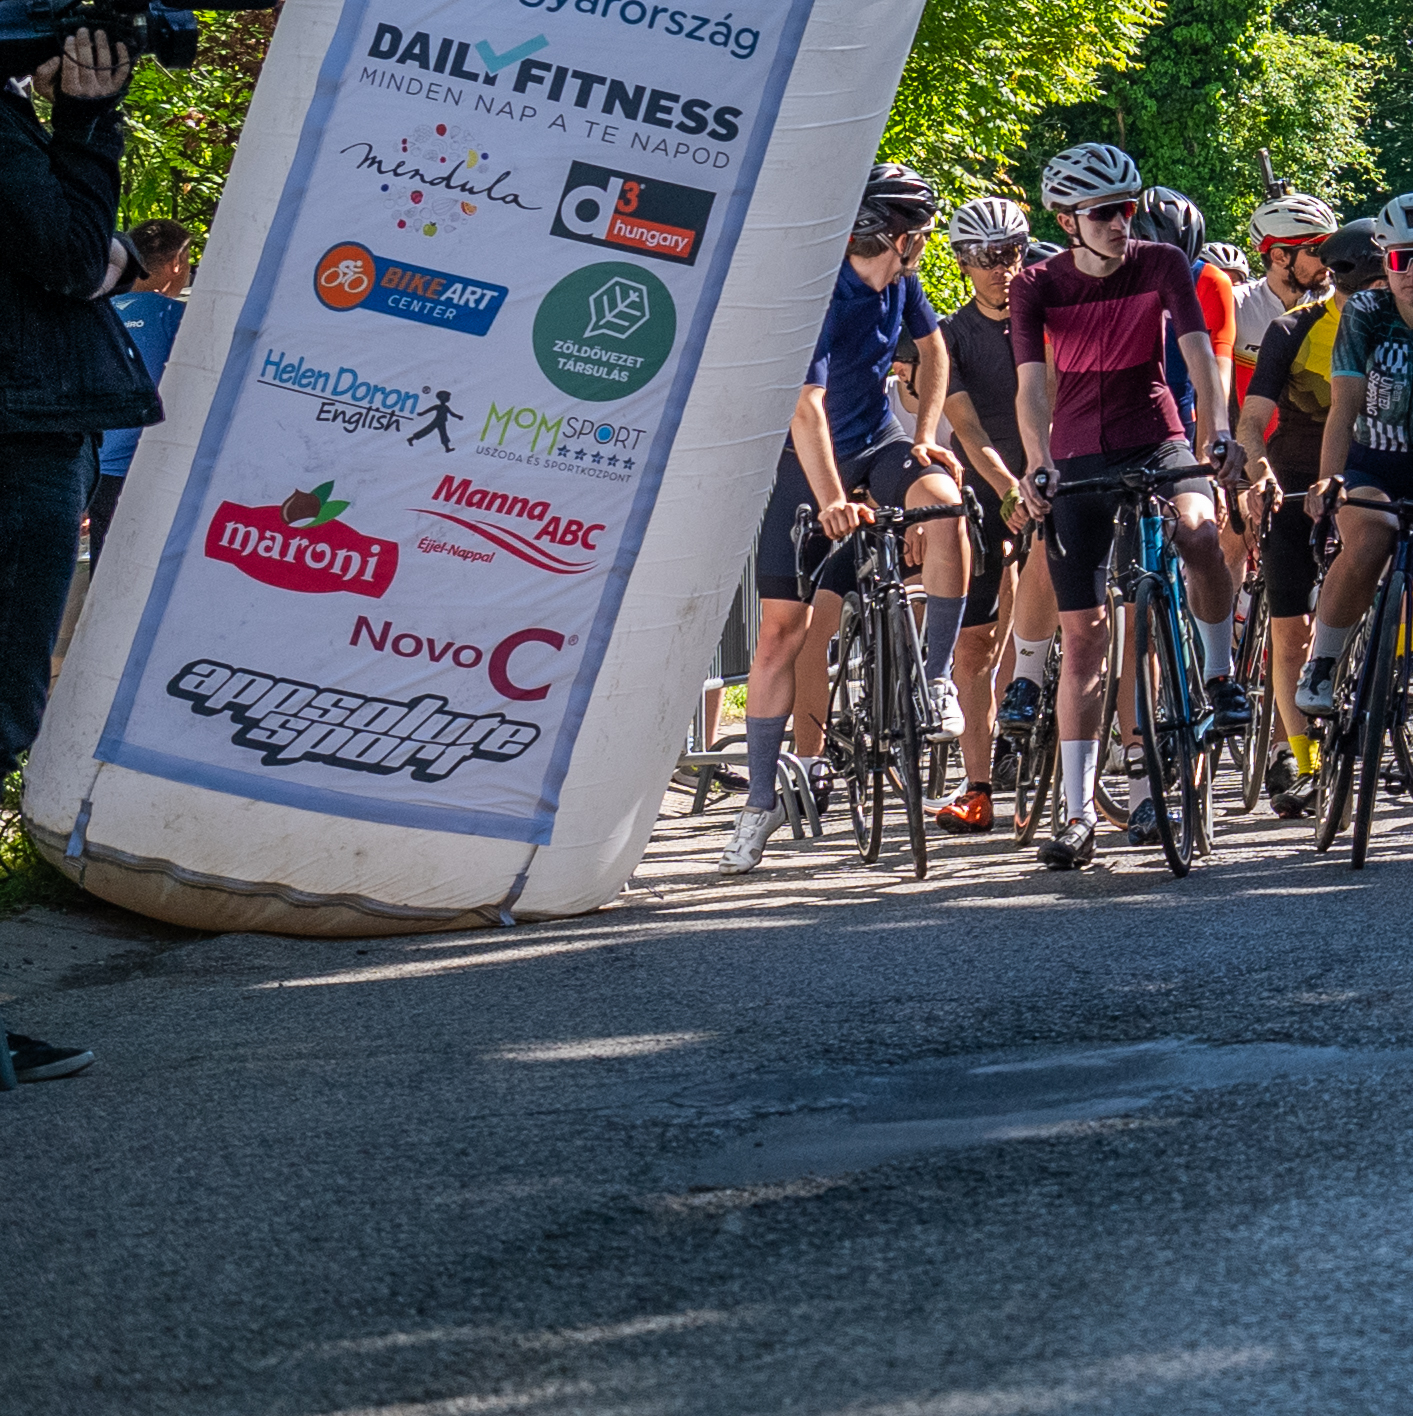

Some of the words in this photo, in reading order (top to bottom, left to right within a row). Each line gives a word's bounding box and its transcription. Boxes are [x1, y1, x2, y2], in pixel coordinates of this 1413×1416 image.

[358, 66, 464, 107] MINDEN
[474, 94, 538, 123] NAP
[548, 113, 568, 133] A
[583, 119, 618, 144] TE
[630, 131, 732, 170] NAPOD
[511, 57, 745, 143] FITNESS
[340, 141, 544, 211] mendula
[613, 218, 690, 252] hungary
[386, 293, 458, 321] CENTER
[258, 347, 331, 395] Helen
[329, 365, 421, 415] Doron
[556, 356, 630, 383] TÁRSULÁS
[1392, 378, 1408, 403] Team
[1366, 370, 1381, 417] SHIPPING
[1378, 376, 1394, 411] UNITED
[315, 400, 402, 434] English
[474, 444, 524, 465] USZODA
[525, 452, 542, 467] ÉS
[541, 457, 633, 484] SPORTKÖZPONT
[430, 473, 552, 523] Manna
[218, 518, 384, 584] maroni
[416, 536, 497, 564] Éjjel-Nappal
[532, 514, 607, 552] ABC
[166, 658, 542, 763] appsolute
[231, 712, 475, 784] sport
